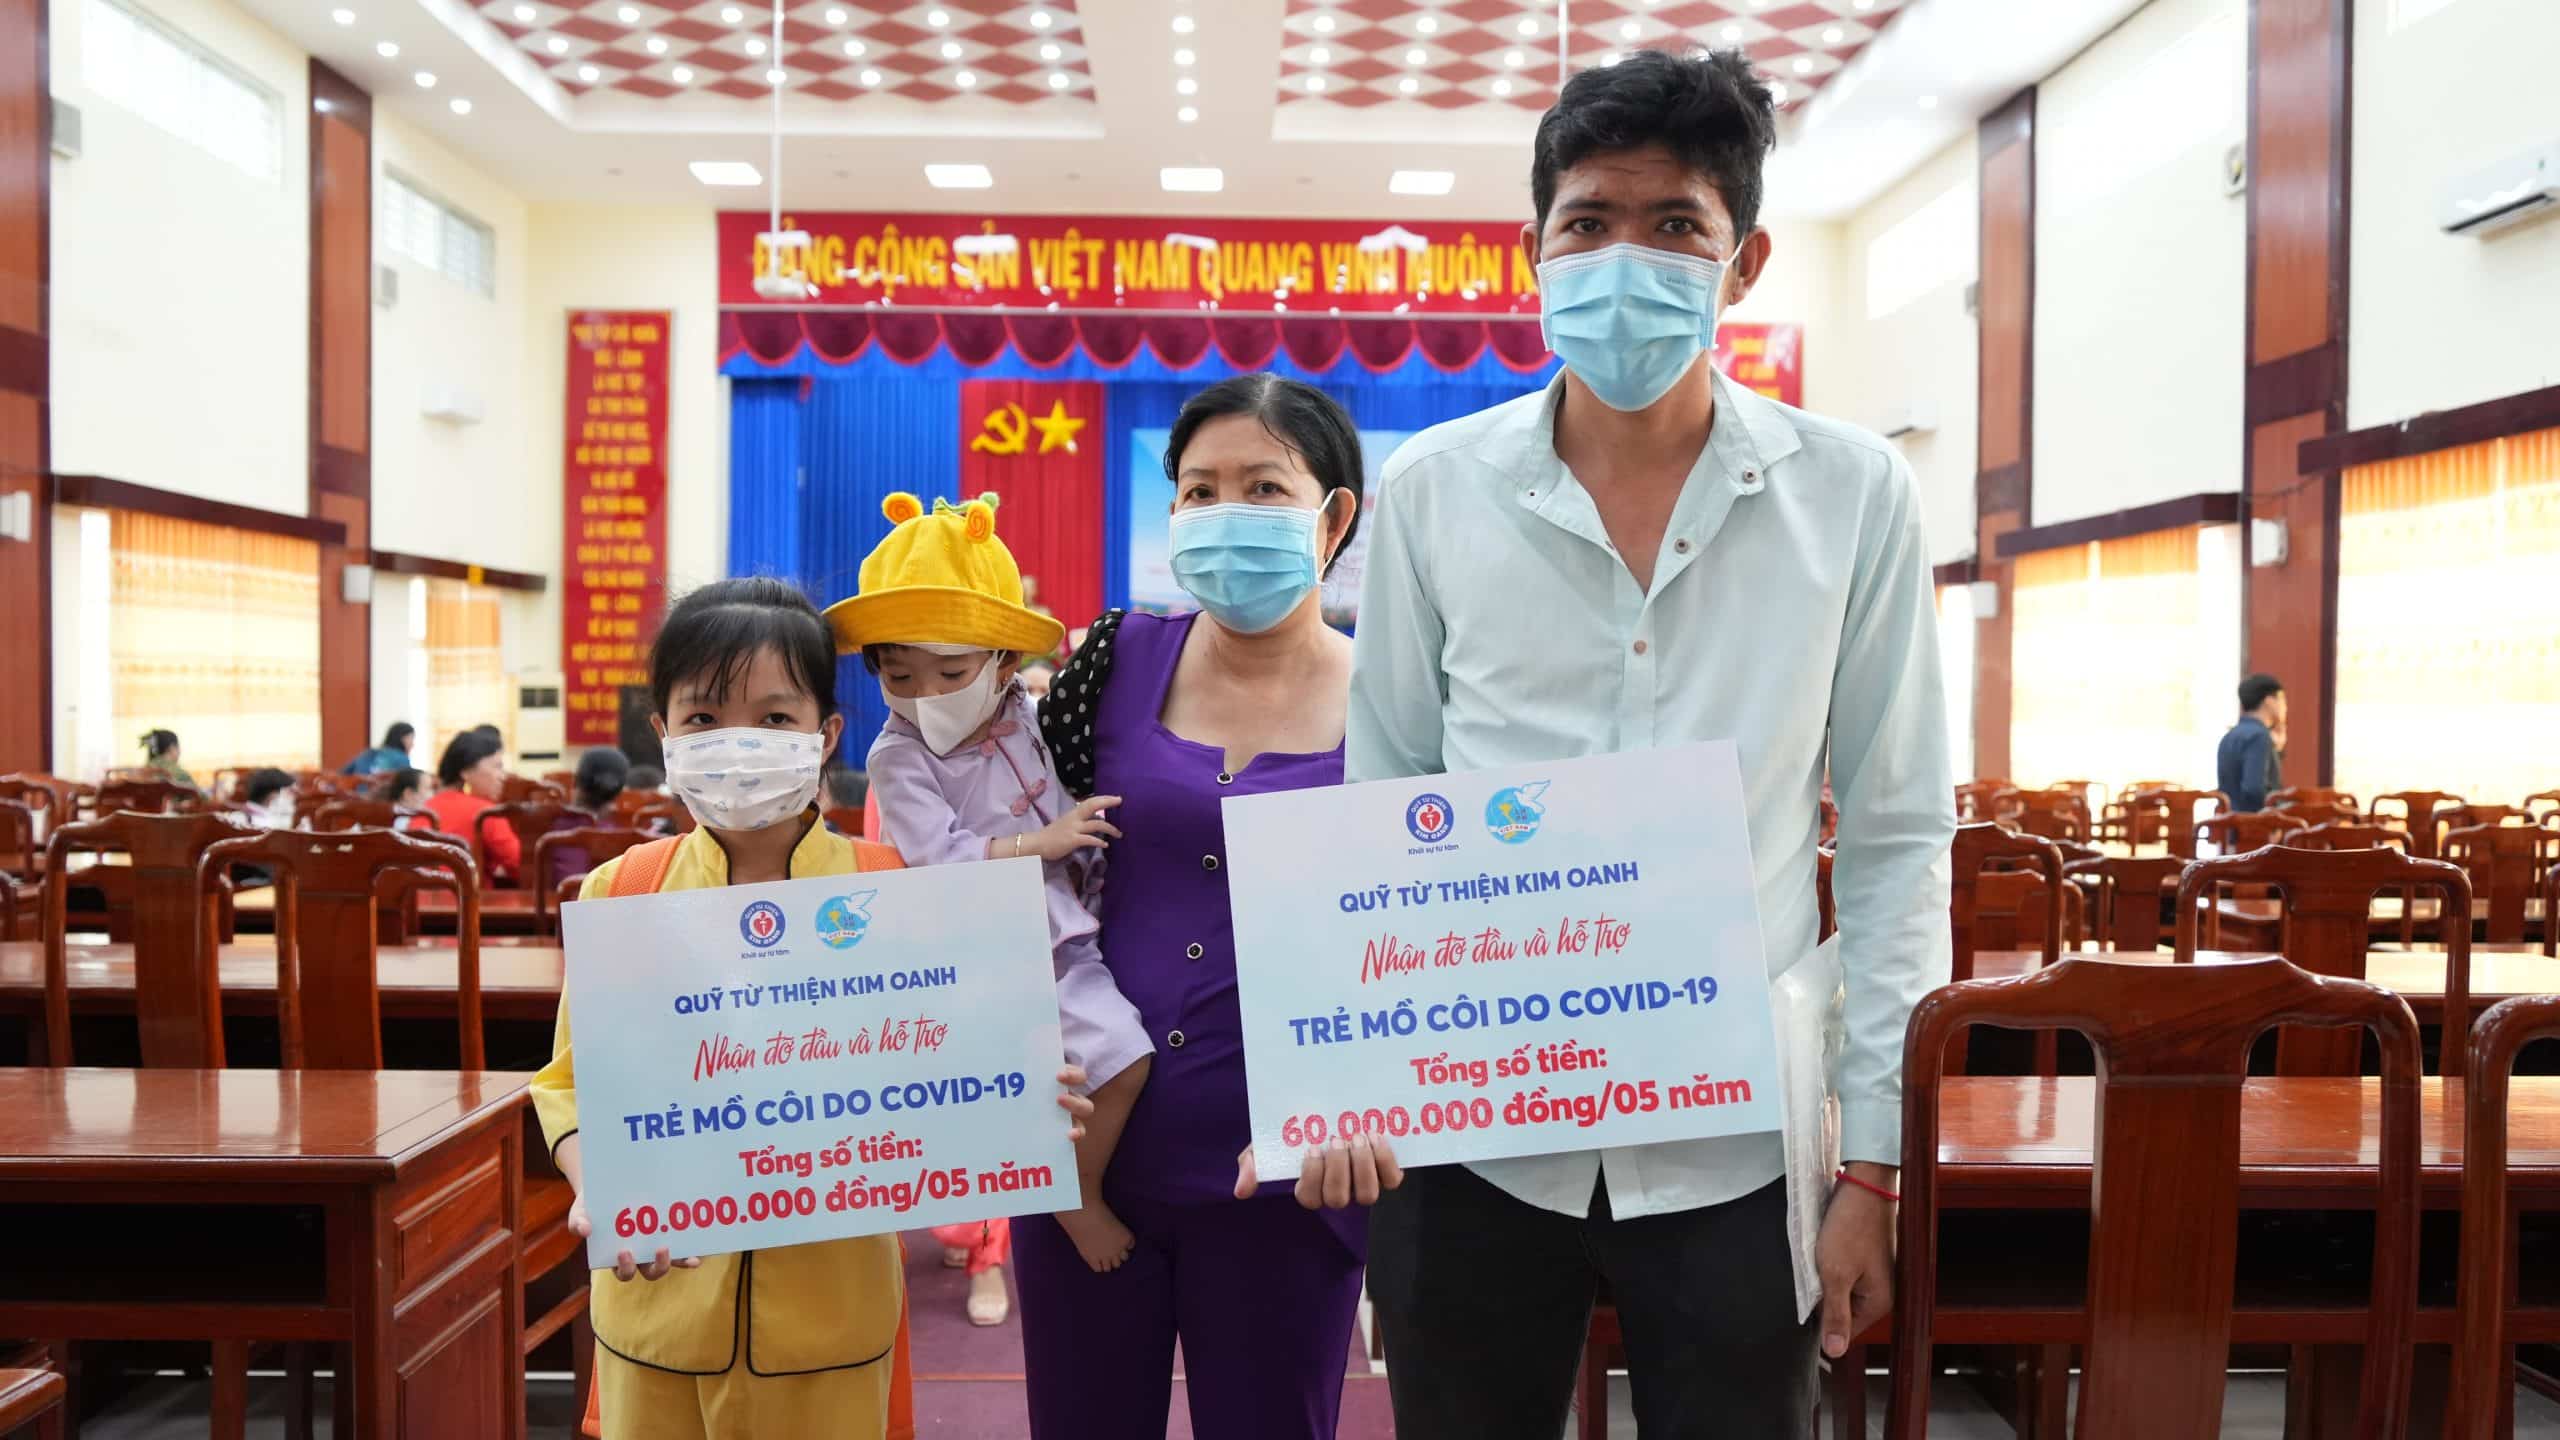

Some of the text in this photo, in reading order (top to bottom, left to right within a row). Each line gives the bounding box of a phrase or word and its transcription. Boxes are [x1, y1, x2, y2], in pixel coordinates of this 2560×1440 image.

[853, 223, 948, 298] CỘNG
[1028, 227, 1105, 301] VIỆT
[1114, 238, 1191, 292] NAM
[1199, 240, 1315, 301] QUANG
[1320, 241, 1398, 295] VINH
[1405, 231, 1502, 296] MUÔN
[1340, 862, 1638, 912] QUỸ TỪ THIỆN KIM OANH
[1361, 932, 1426, 984] Nhận
[1435, 931, 1467, 967] đỡ
[1472, 926, 1517, 964] đầu
[1524, 927, 1551, 957] và
[1557, 917, 1589, 954] hỗ
[675, 967, 956, 1014] QUỸ TỪ THIỆN KIM OANH
[1289, 977, 1717, 1045] TRẺ MỒ CÔI DO COVID-19
[694, 1032, 755, 1082] Nhận
[764, 1030, 794, 1065] đỡ
[800, 1026, 842, 1061] đầu
[849, 1027, 873, 1055] và
[879, 1017, 910, 1052] hỗ
[1410, 1040, 1607, 1087] Tổng số tiền:
[624, 1072, 1025, 1141] TRẺ MỒ CÔI DO COVID-19
[1503, 1080, 1659, 1127] đồng/05
[1669, 1074, 1751, 1109] năm
[739, 1131, 923, 1178] Tổng số tiền:
[615, 1162, 1052, 1238] 60.000.000 đồng/05 năm
